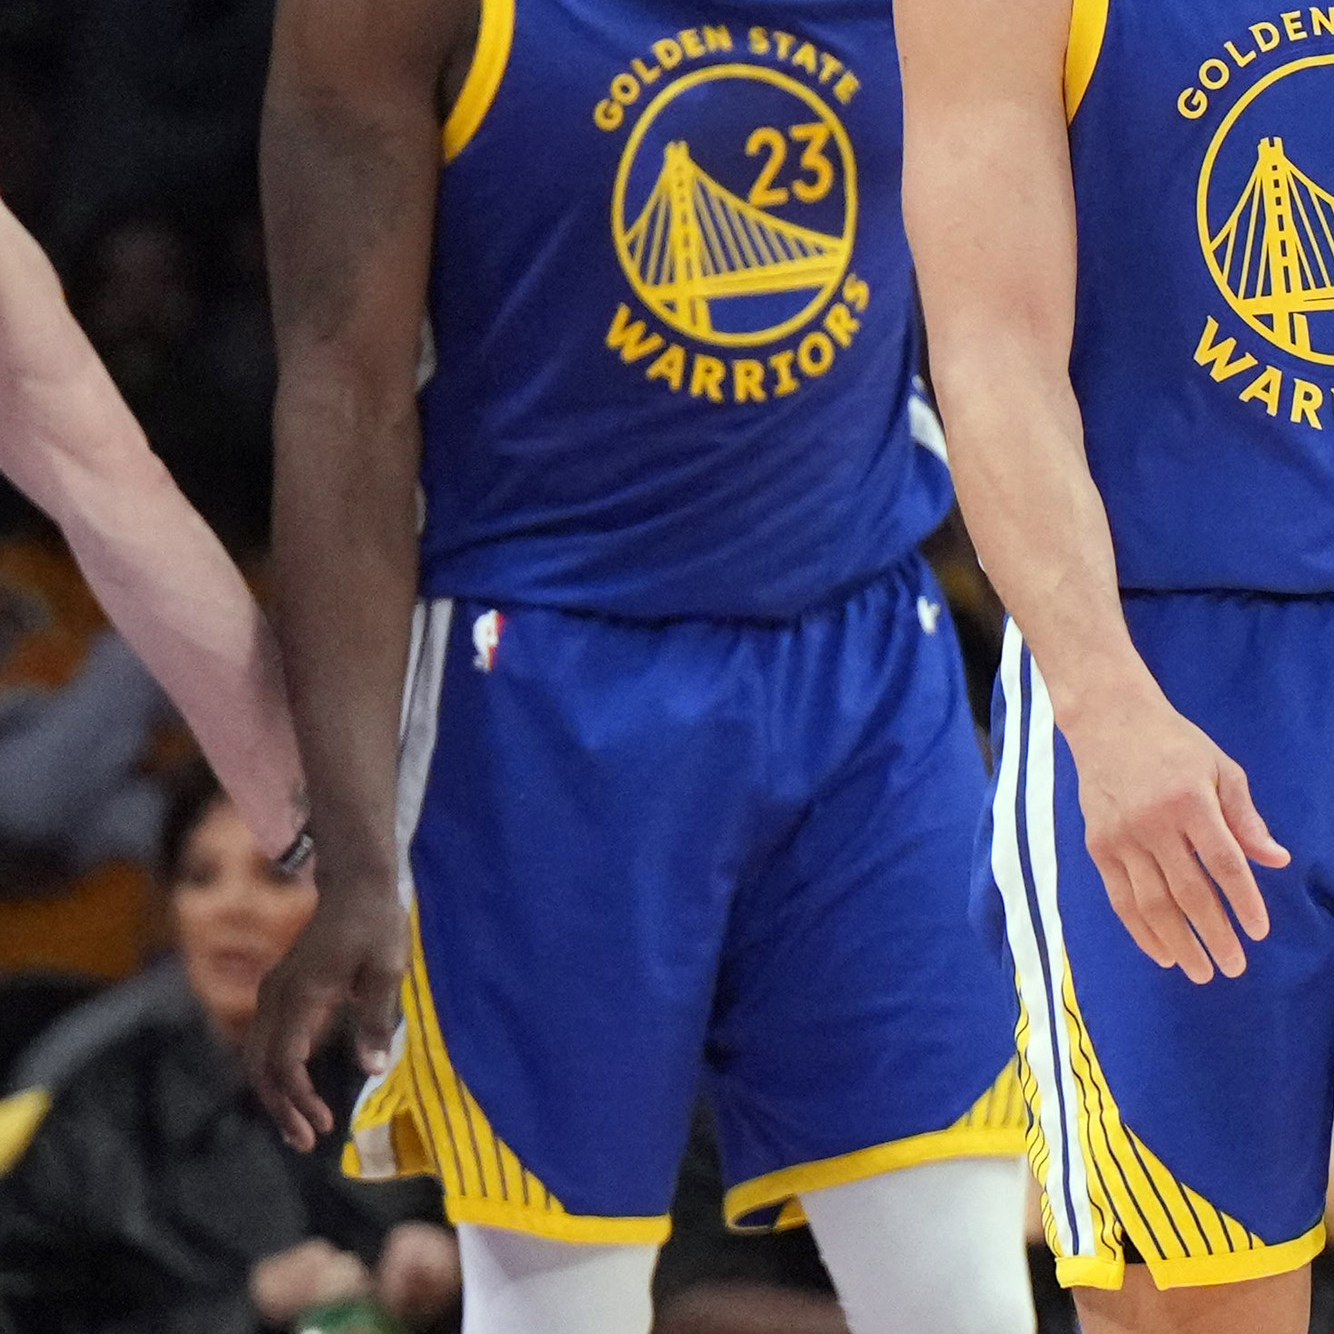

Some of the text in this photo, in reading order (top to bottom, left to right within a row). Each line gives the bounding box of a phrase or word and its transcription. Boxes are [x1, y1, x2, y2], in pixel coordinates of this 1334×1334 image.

[594, 24, 863, 131] GOLDEN STATE
[743, 123, 835, 209] 23
[604, 272, 870, 404] WARRIORS
